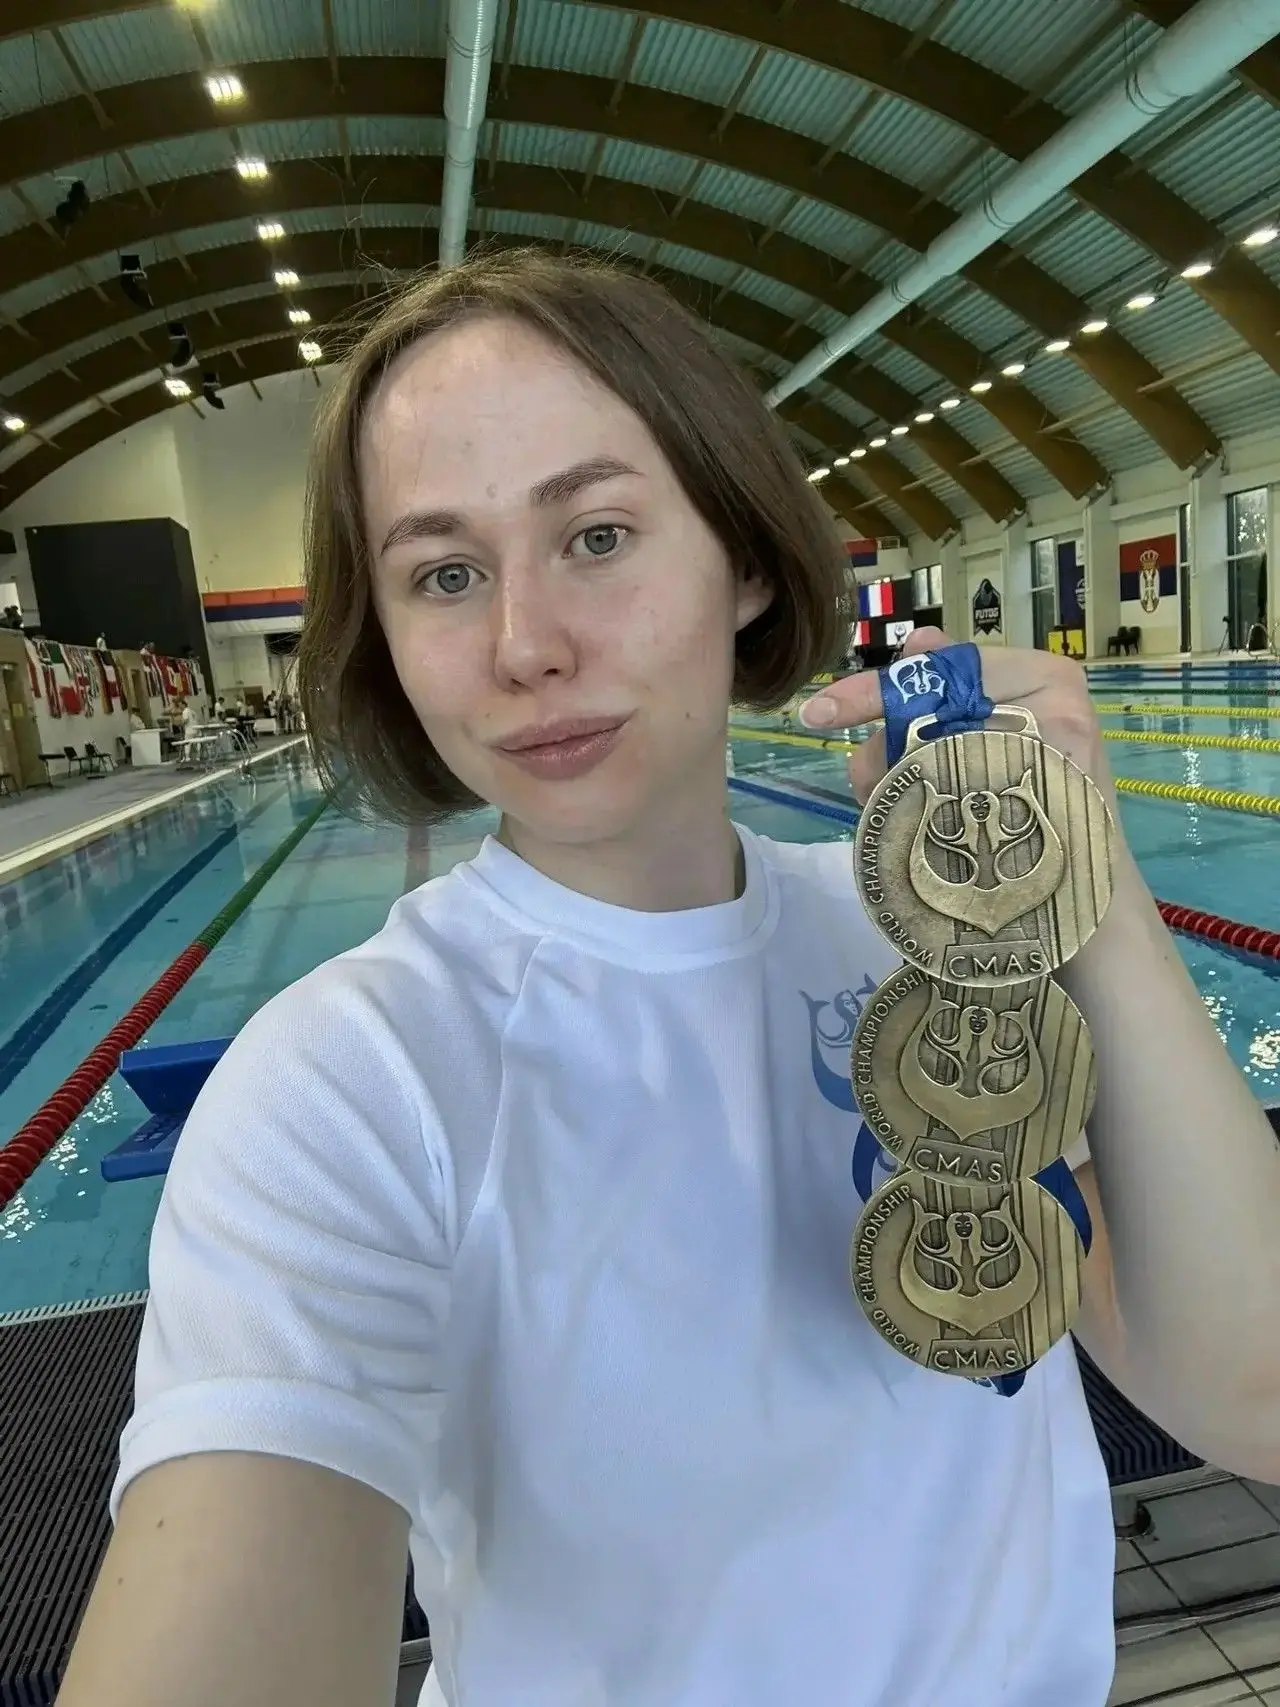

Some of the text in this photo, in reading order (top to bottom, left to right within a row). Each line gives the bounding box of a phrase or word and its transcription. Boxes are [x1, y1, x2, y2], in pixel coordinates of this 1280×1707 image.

[863, 764, 935, 967] WORLD CHAMPIONSHIP
[949, 951, 1044, 979] CMAS
[862, 1093, 904, 1151] WORLD
[914, 1149, 1003, 1183] CMAS
[856, 1185, 920, 1357] WORLD CHAMPIONSHIP
[934, 1350, 1018, 1369] CMAS
